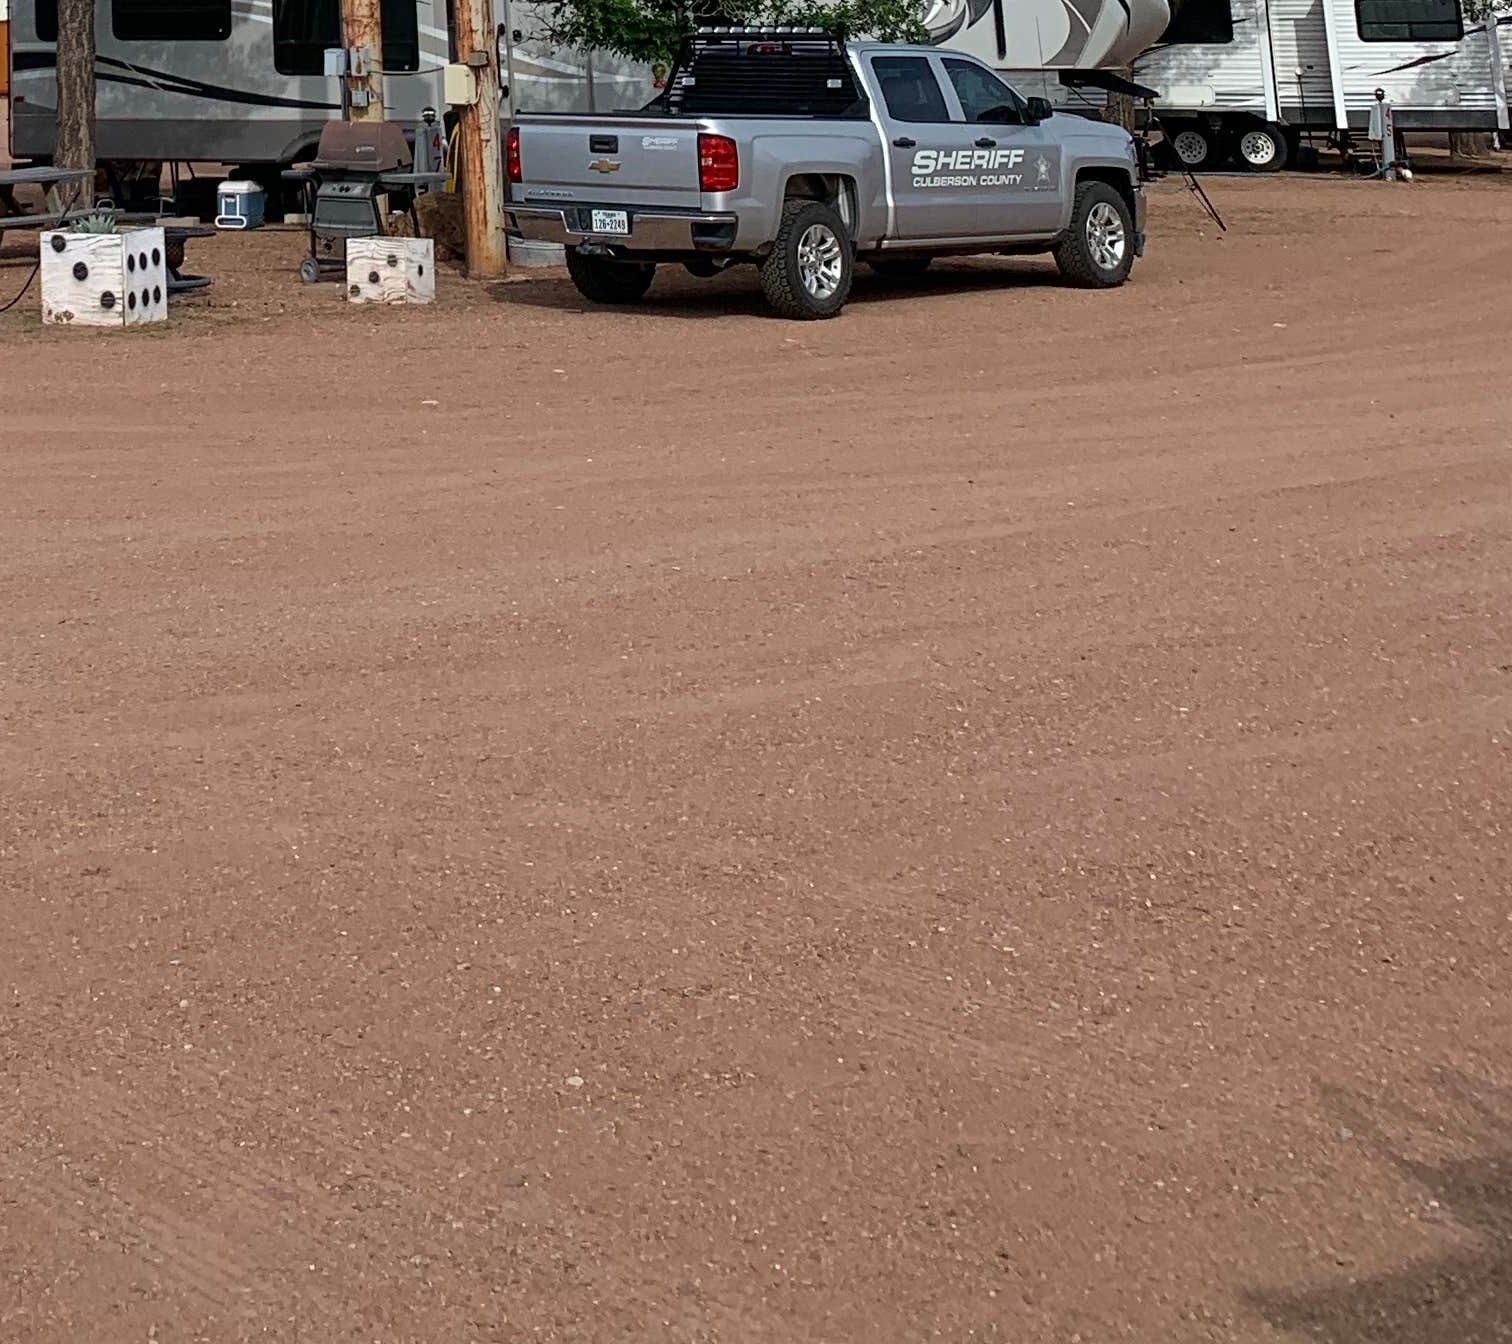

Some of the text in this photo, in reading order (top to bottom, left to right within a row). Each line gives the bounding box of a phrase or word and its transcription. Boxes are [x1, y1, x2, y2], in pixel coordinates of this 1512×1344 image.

[911, 149, 1025, 175] SHERIFF
[913, 174, 1023, 187] CULBERSON COUNTY
